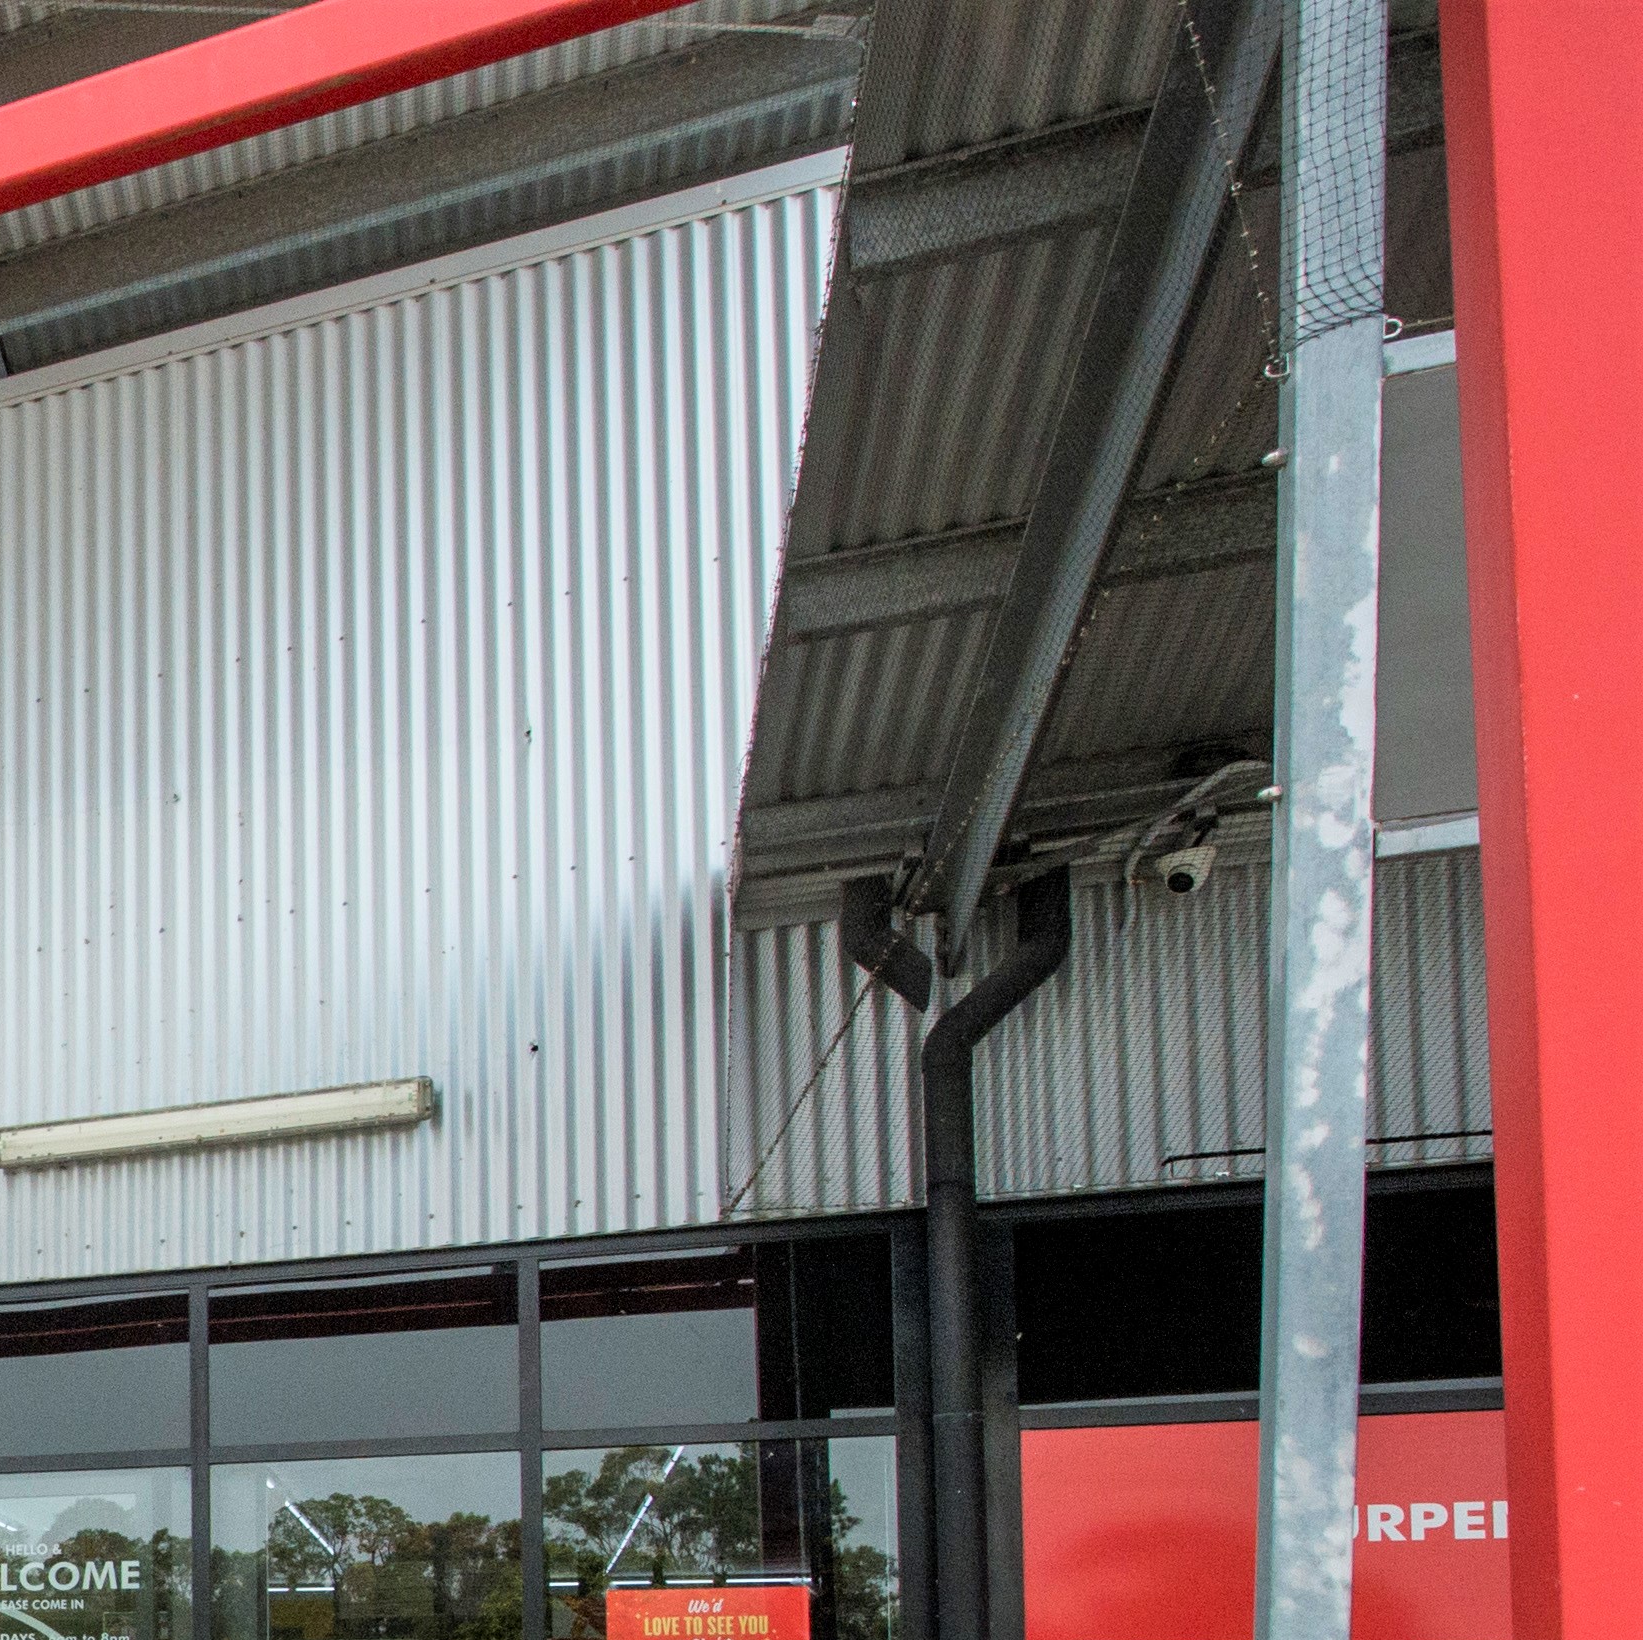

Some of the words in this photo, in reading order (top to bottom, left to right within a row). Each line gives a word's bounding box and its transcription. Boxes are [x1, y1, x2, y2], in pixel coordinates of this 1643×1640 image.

[5, 1544, 48, 1556] HELLO
[53, 1543, 62, 1555] &
[32, 1599, 68, 1610] COME
[71, 1599, 85, 1610] IN
[687, 1599, 724, 1613] We'd
[643, 1616, 680, 1636] LOVE
[684, 1616, 703, 1636] TO
[707, 1616, 735, 1636] SEE
[739, 1615, 769, 1635] YOU
